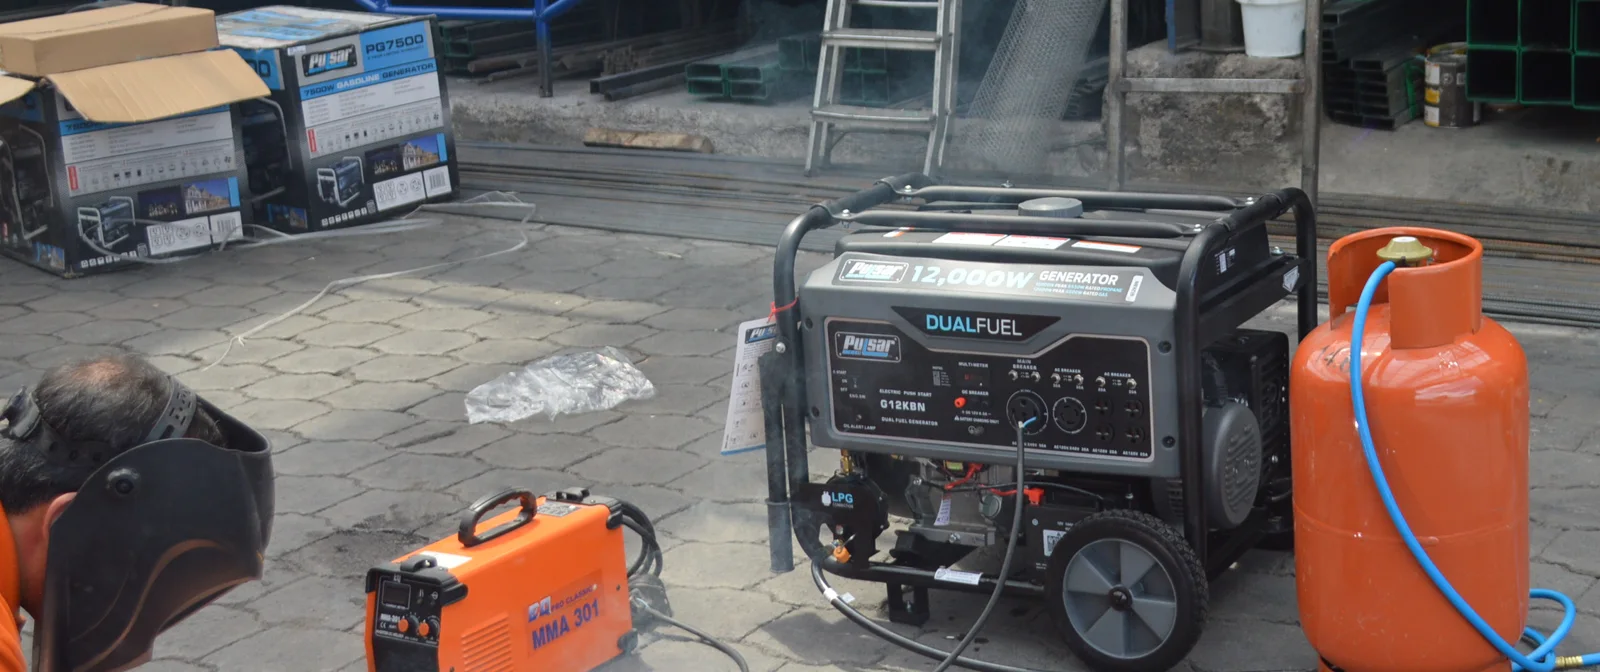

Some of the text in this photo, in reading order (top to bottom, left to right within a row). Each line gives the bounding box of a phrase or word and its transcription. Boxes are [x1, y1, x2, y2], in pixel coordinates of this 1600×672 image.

[365, 34, 424, 55] PG7500
[304, 84, 335, 97] 7500W
[336, 73, 380, 89] GASOLINE
[382, 62, 434, 79] GENERATOR
[911, 265, 1034, 289] 12,000W
[1039, 270, 1119, 286] GENERATOR
[842, 335, 896, 357] Pulsar
[880, 399, 926, 412] G12KBN
[908, 418, 938, 426] GENERATOR
[832, 491, 854, 504] LPG
[551, 600, 565, 612] PRO
[532, 598, 599, 650] MMA 301
